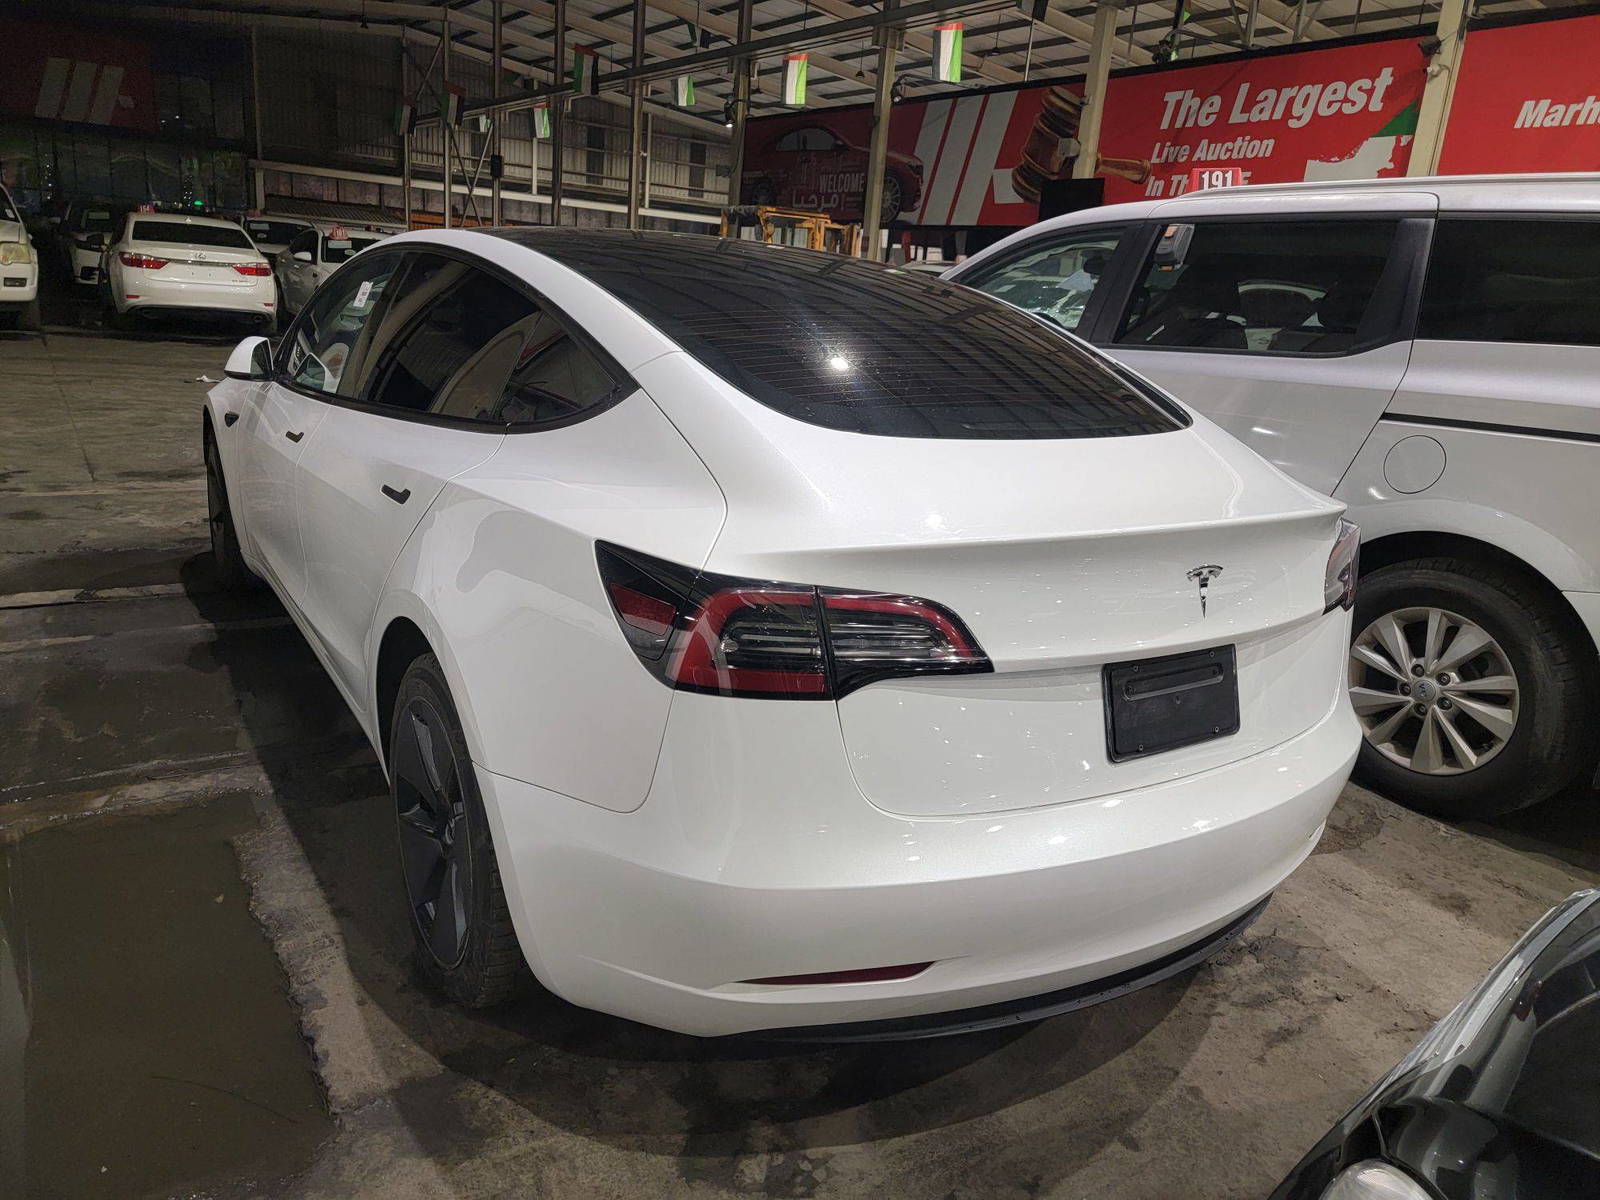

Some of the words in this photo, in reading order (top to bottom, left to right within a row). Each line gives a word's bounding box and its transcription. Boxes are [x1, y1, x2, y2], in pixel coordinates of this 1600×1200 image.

[1160, 89, 1222, 130] The
[1228, 67, 1394, 129] Largest
[1151, 142, 1190, 164] Live
[1192, 136, 1275, 162] Auction
[820, 172, 865, 193] WELCOME
[1145, 175, 1165, 197] In
[1202, 170, 1233, 190] 191
